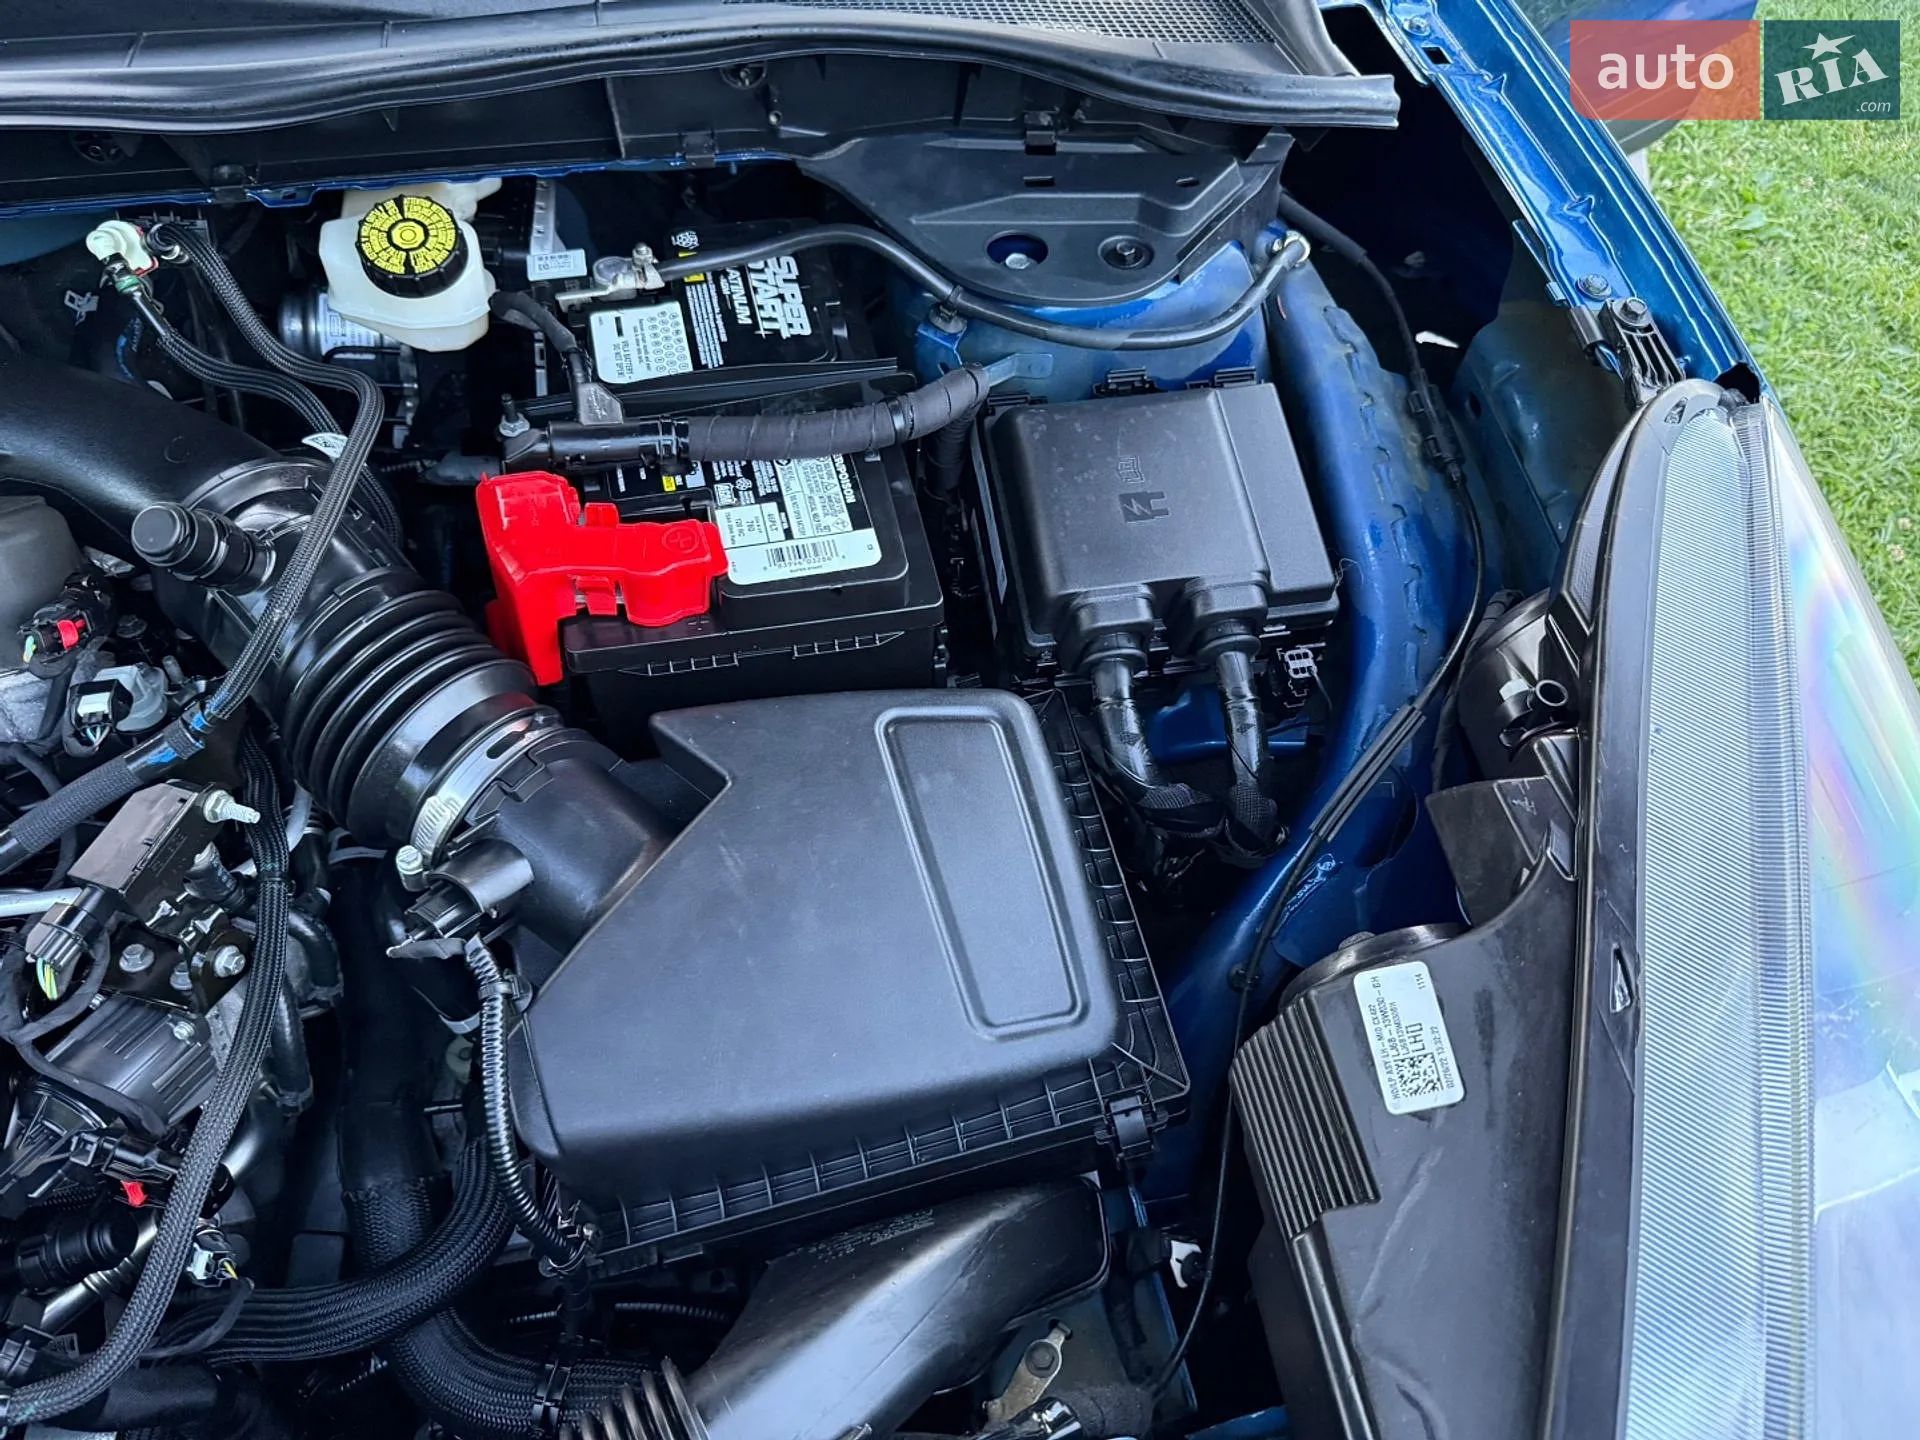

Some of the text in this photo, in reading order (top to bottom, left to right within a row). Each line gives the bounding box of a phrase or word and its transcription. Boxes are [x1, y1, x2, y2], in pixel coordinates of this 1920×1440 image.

[726, 267, 752, 325] ATINUM
[772, 256, 811, 335] SUPER
[833, 453, 855, 503] ER/POISON
